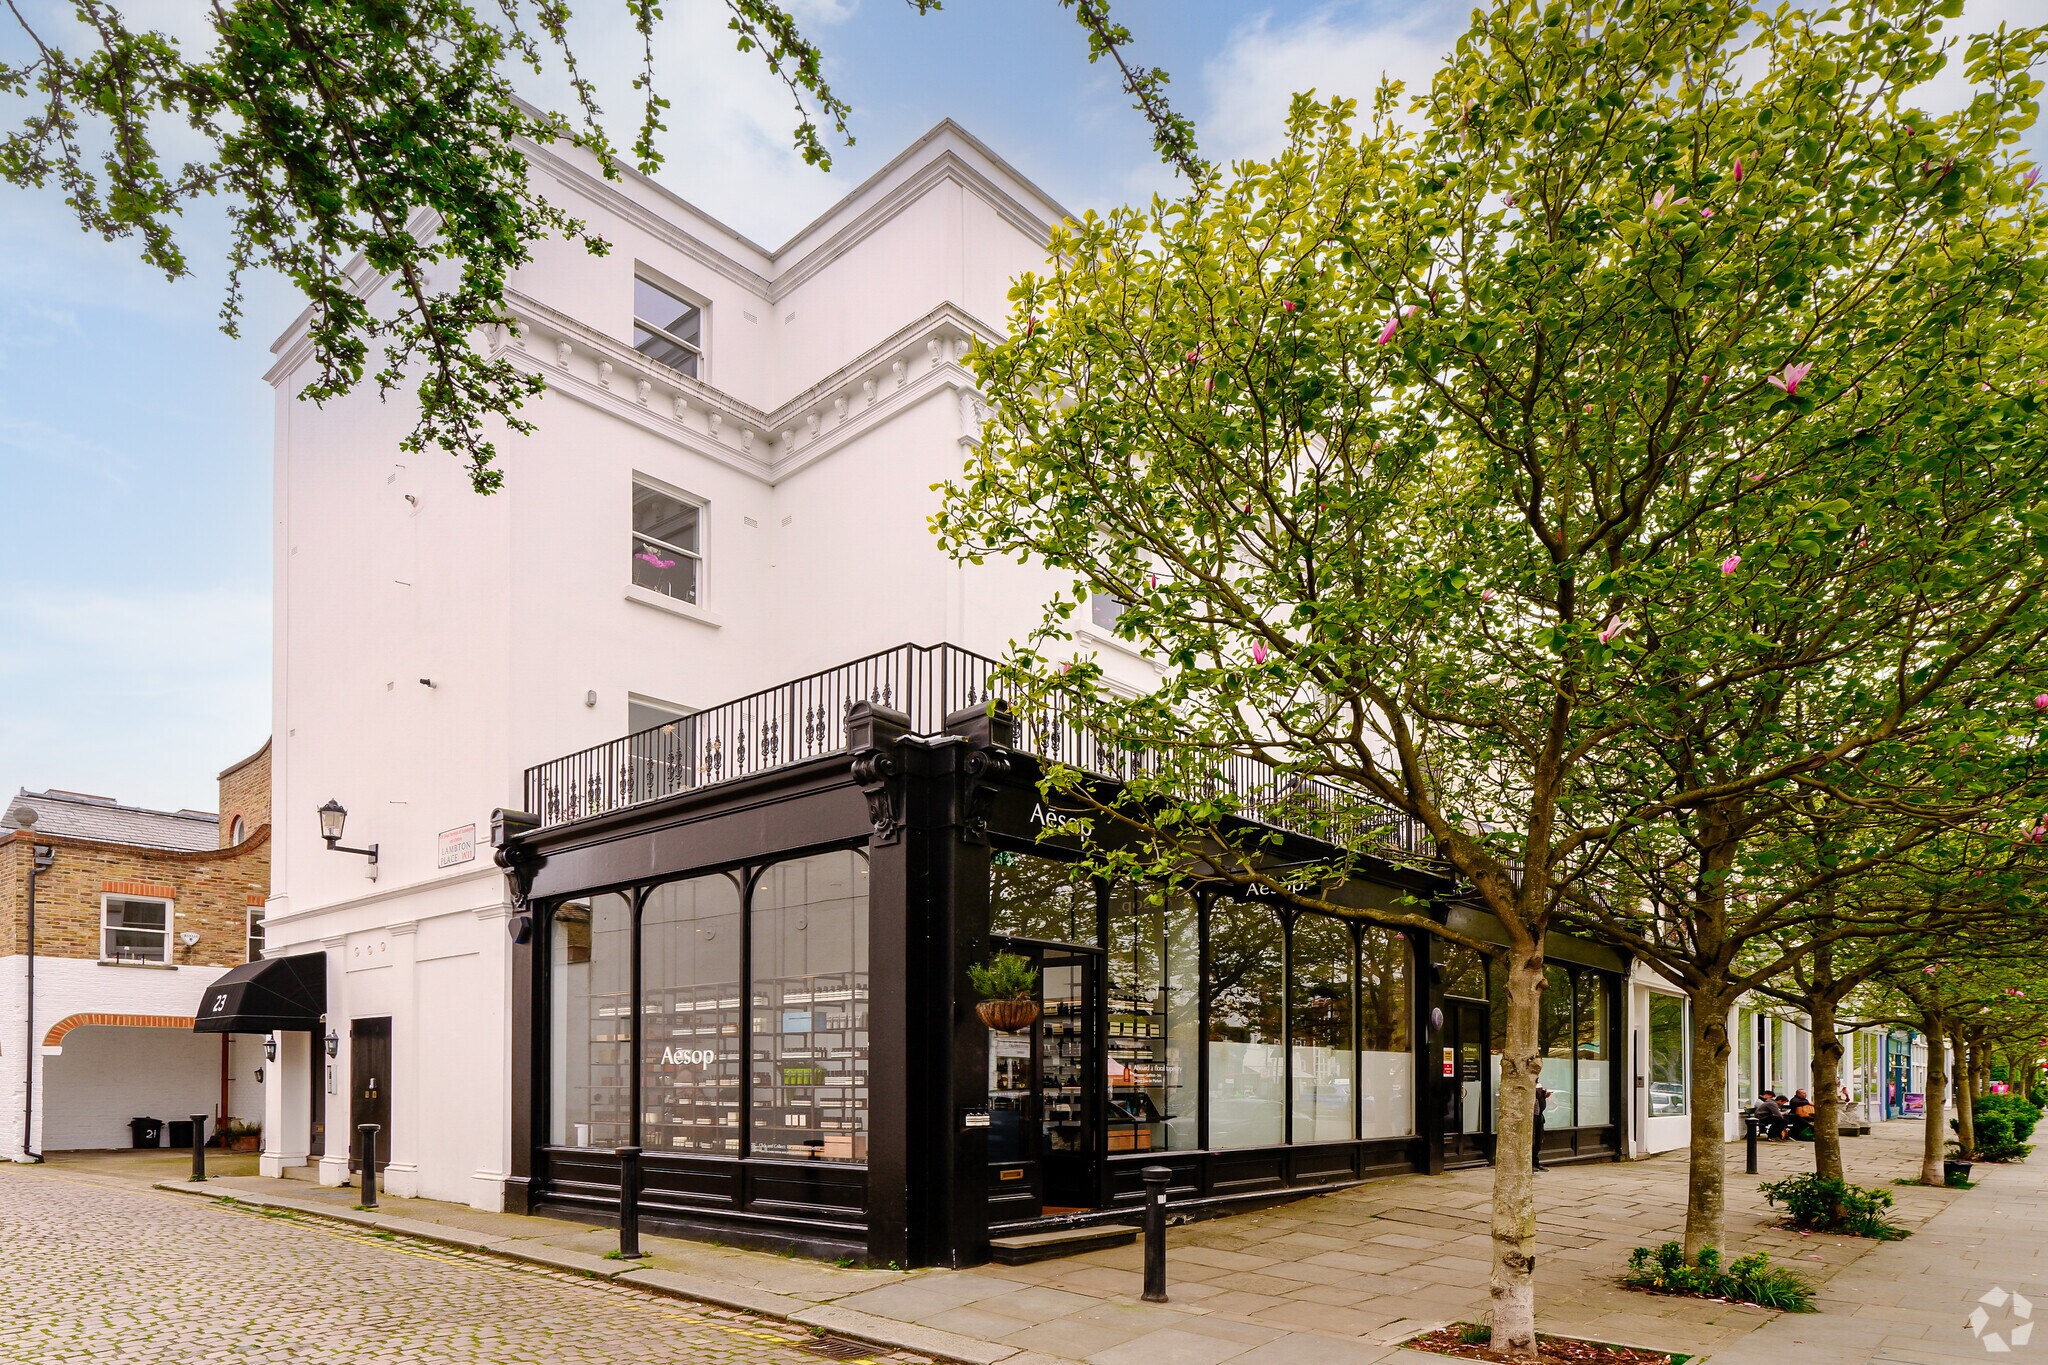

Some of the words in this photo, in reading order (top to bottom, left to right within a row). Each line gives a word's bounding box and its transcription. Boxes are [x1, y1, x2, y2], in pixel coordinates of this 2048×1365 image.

[441, 841, 471, 855] LAMBTON
[440, 854, 458, 865] PLACE
[212, 994, 227, 1012] 23
[661, 1046, 714, 1070] Aēsop
[146, 1129, 157, 1139] 21
